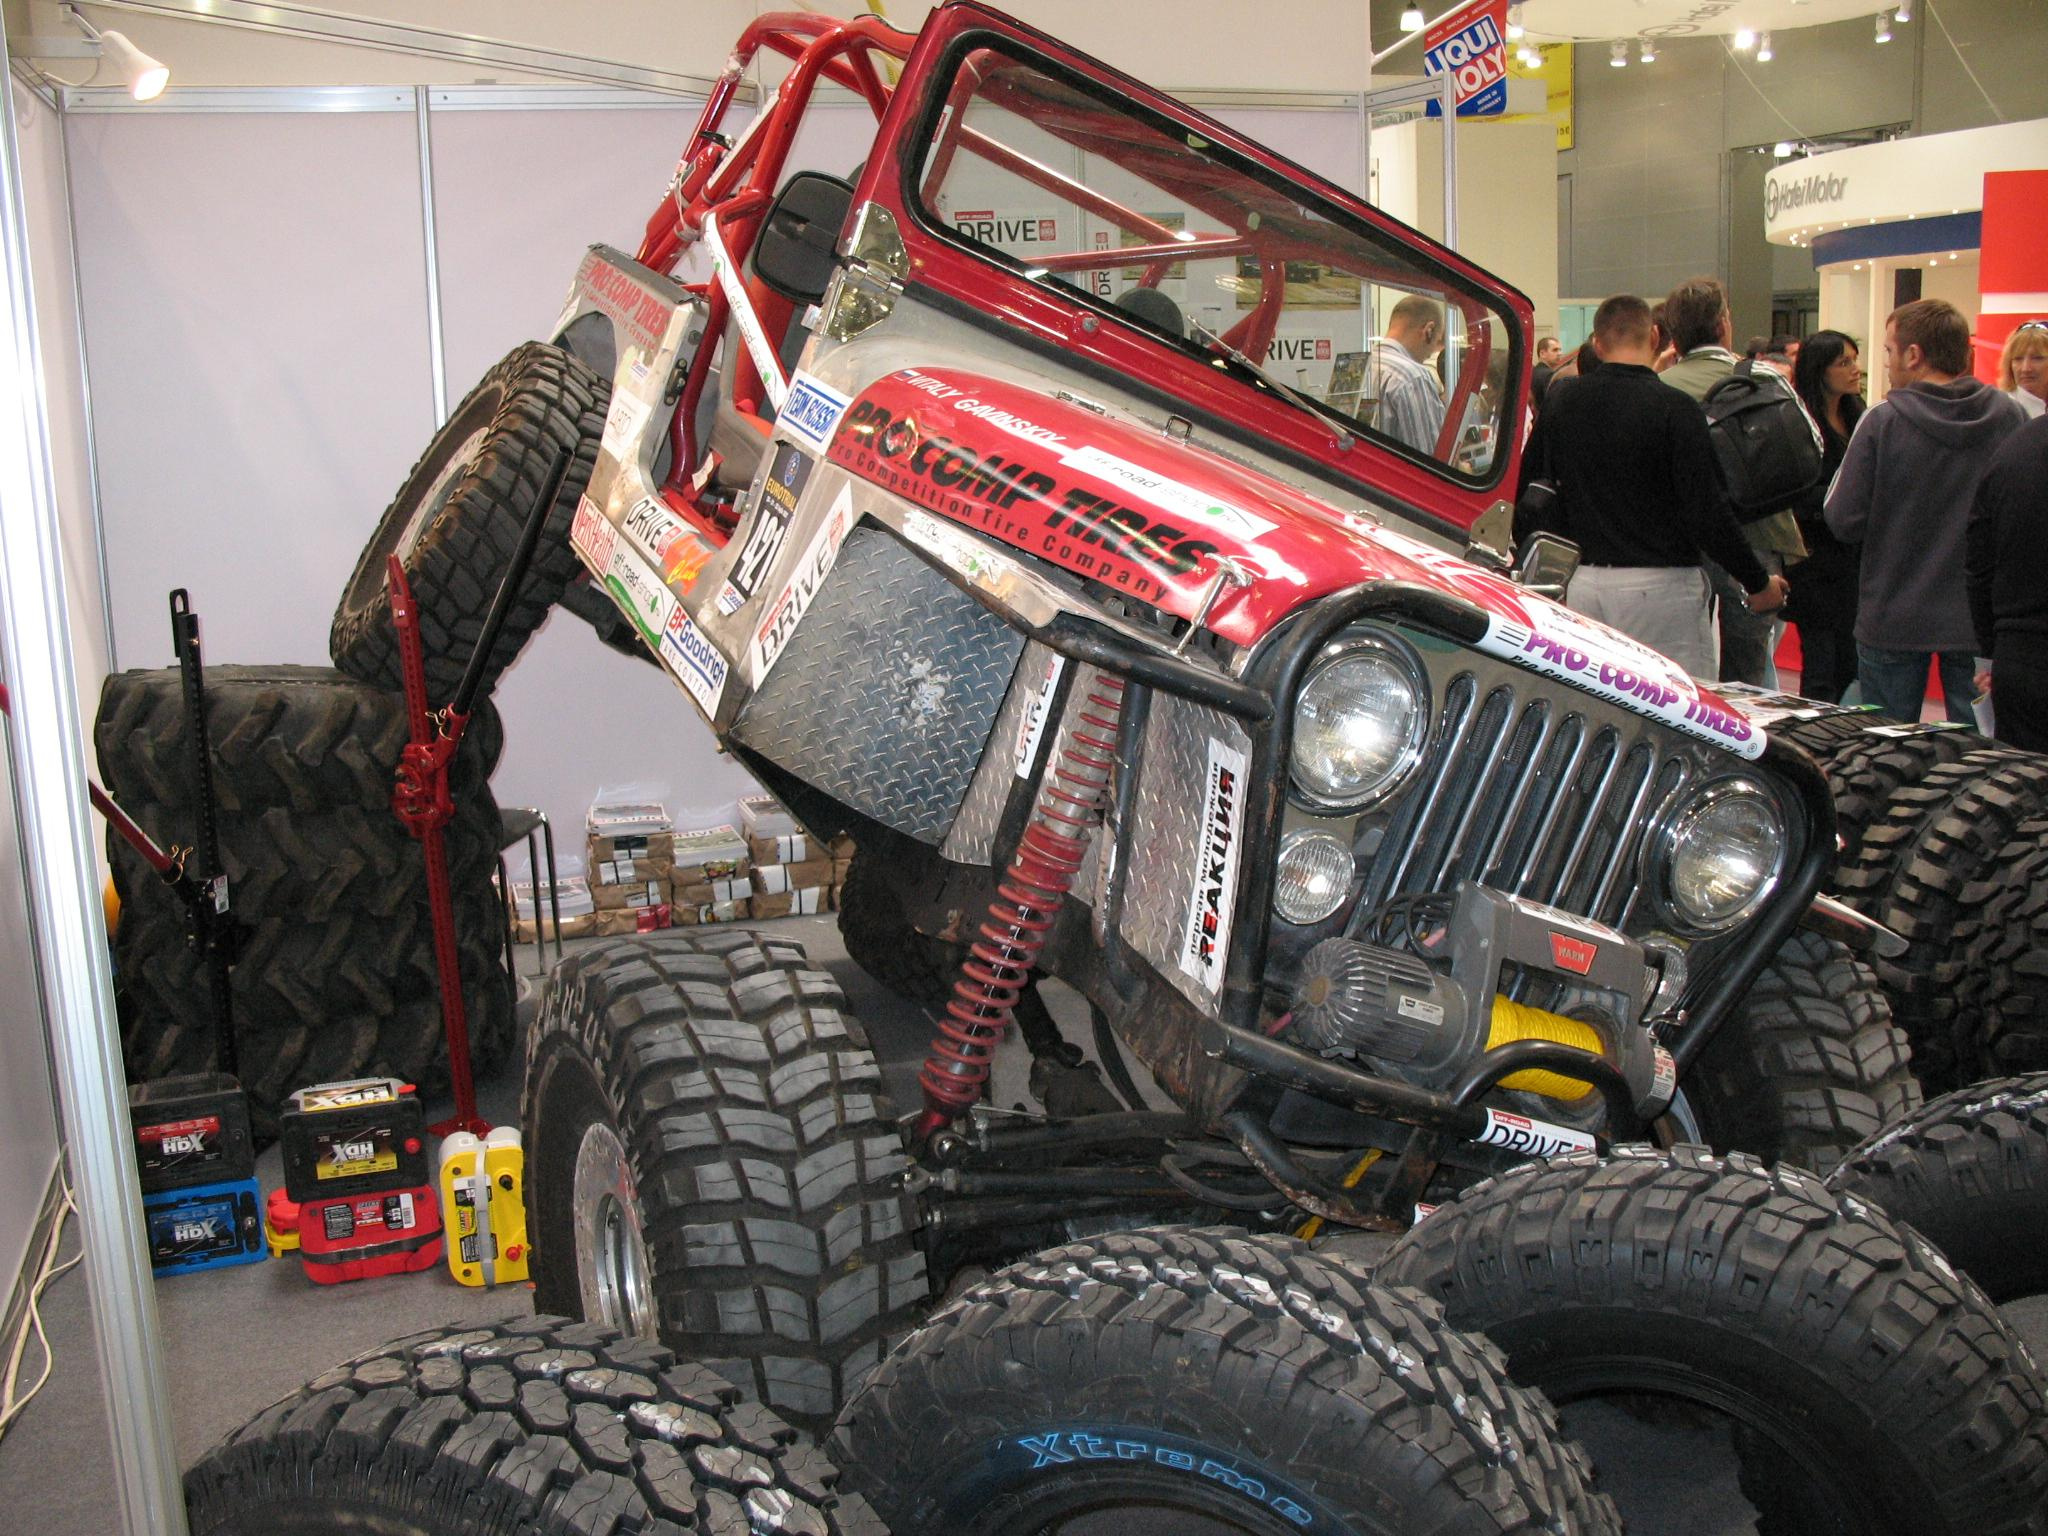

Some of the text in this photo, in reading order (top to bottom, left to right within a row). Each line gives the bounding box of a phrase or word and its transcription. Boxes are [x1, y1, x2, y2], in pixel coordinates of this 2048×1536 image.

[1425, 20, 1496, 77] LIQUI
[1805, 172, 1848, 206] Motor
[957, 220, 1037, 242] DRIVE
[907, 375, 963, 398] VITALY
[626, 499, 674, 550] DRIVE
[856, 452, 973, 519] Competition
[982, 507, 1029, 542] Tire
[1042, 534, 1168, 603] Company
[910, 436, 1056, 510] COMP
[1045, 487, 1220, 578] TIRES
[761, 535, 831, 669] DRIVE
[668, 605, 726, 688] BFGoodrich
[1523, 631, 1589, 671] PRO
[1600, 661, 1679, 708] COMP
[1685, 695, 1752, 742] TIRES
[1558, 945, 1586, 962] WARN
[163, 1131, 206, 1155] HDX
[175, 1217, 218, 1242] HDX
[1018, 1432, 1313, 1526] Xtreme
